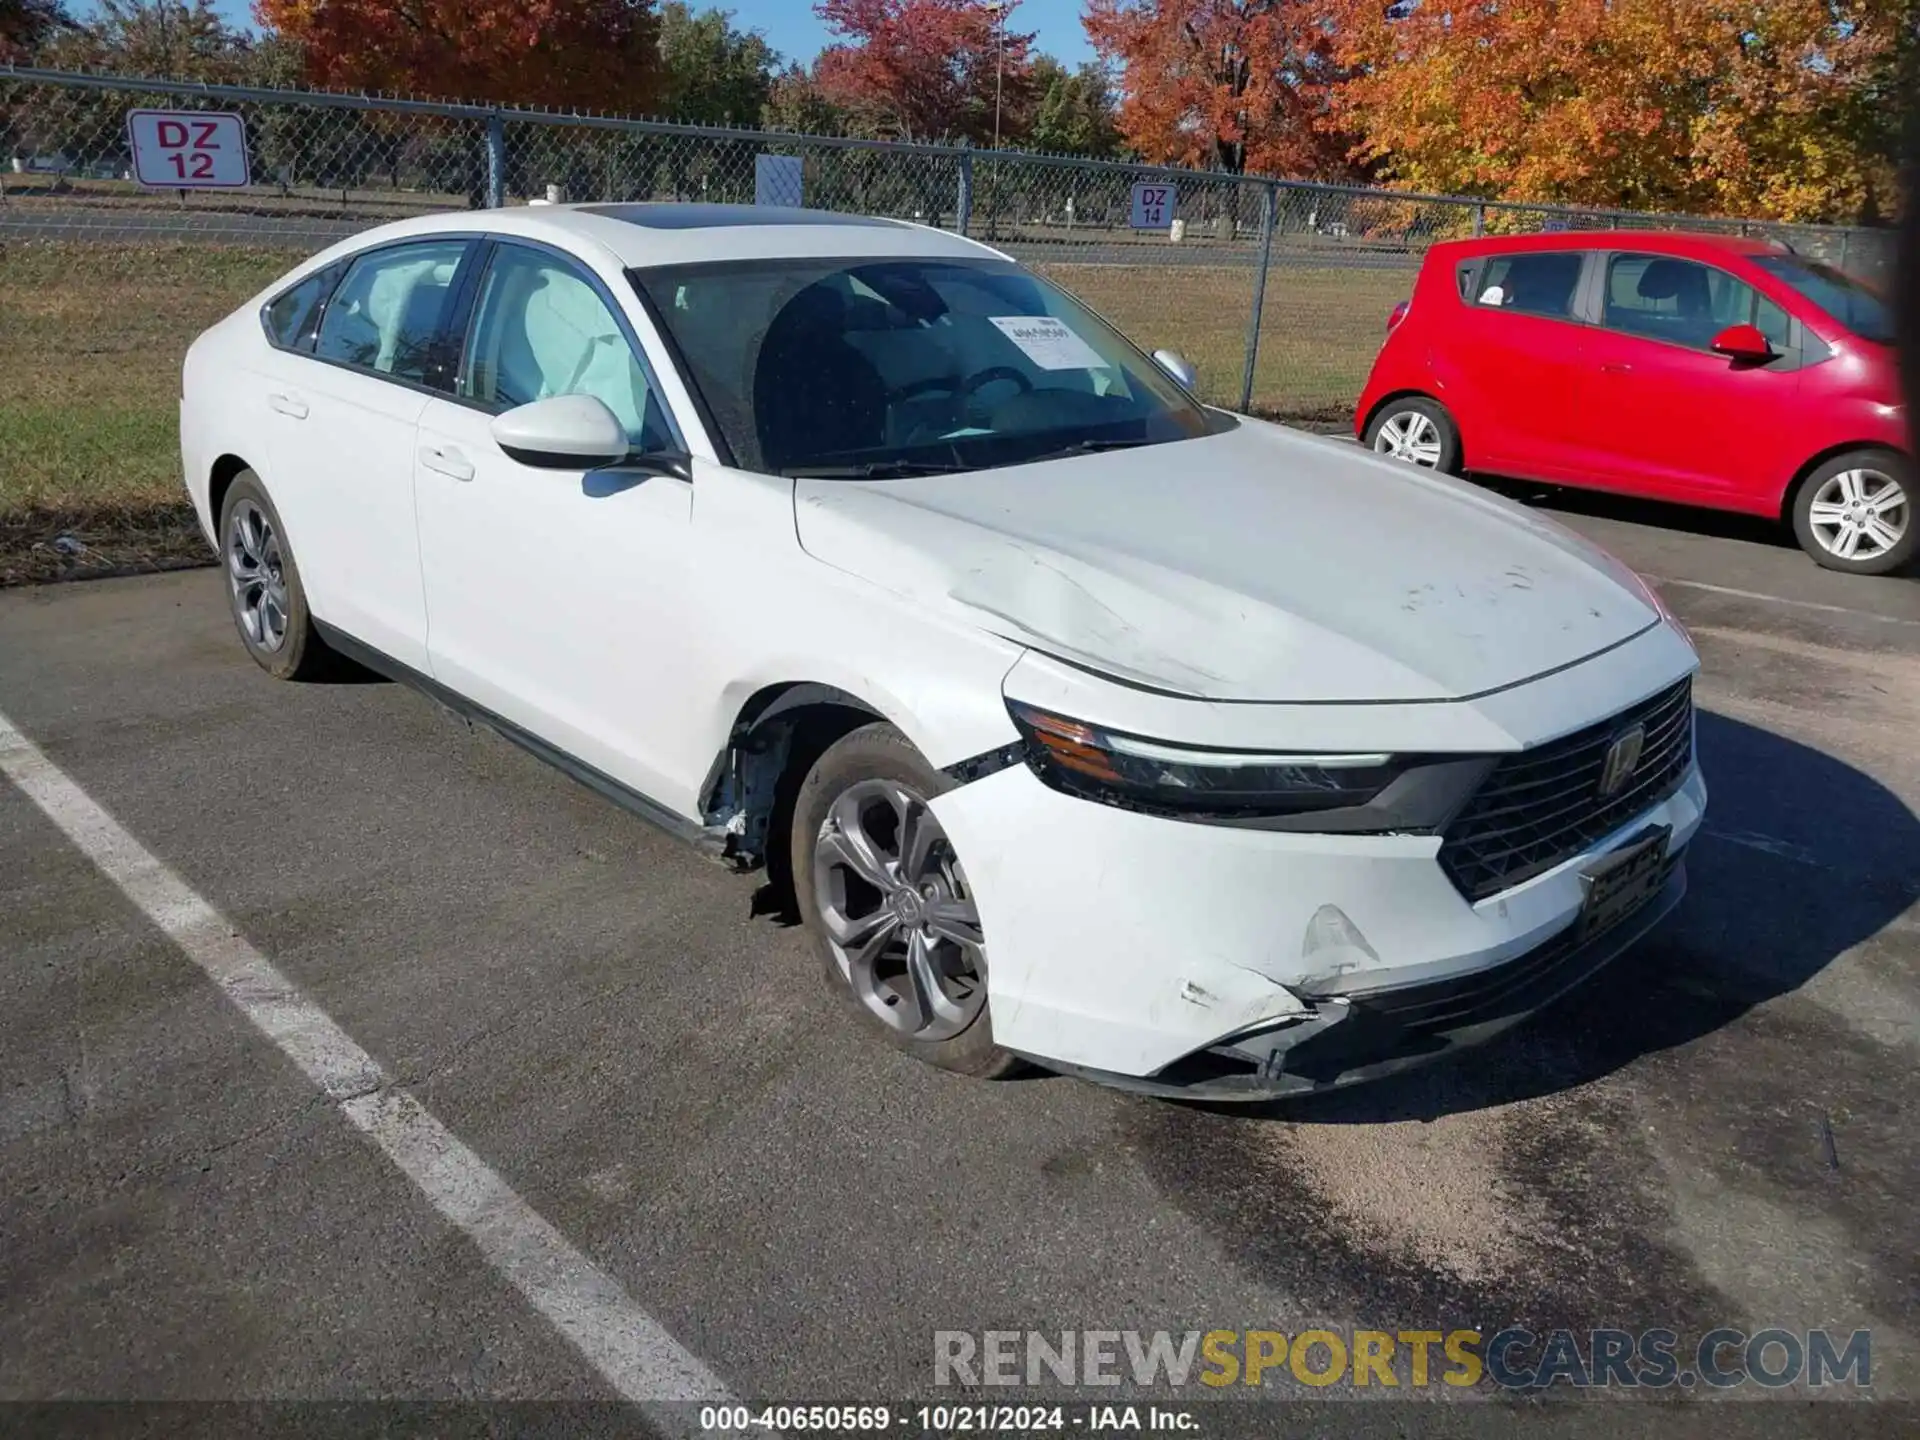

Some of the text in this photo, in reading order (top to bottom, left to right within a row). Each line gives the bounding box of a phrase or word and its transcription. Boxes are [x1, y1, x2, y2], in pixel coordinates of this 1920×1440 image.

[157, 121, 221, 149] DZ
[167, 152, 215, 178] 12
[1142, 189, 1168, 205] DZ
[1143, 208, 1160, 224] 14
